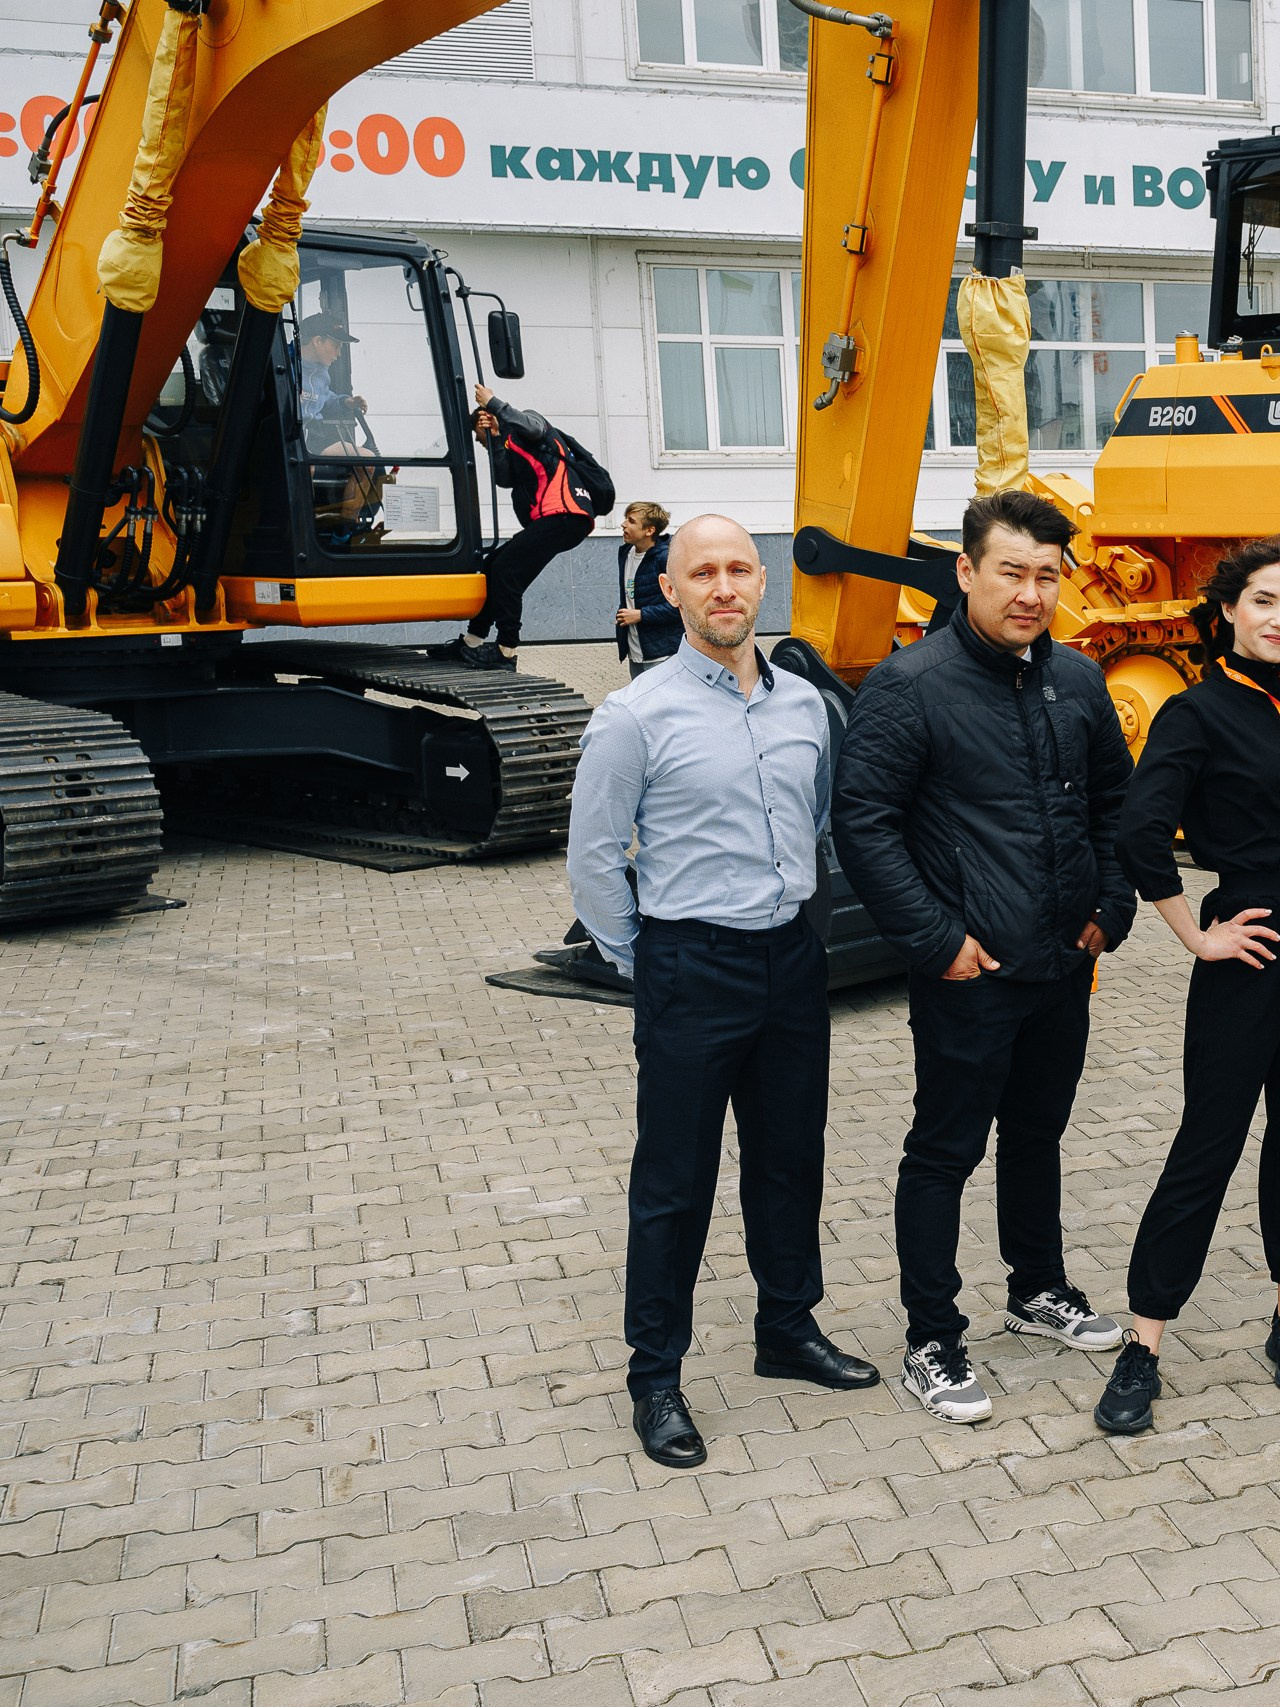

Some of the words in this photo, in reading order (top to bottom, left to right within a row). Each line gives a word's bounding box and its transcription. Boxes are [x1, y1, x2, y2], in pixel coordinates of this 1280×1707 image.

[489, 144, 771, 199] каждую
[1084, 174, 1116, 206] и
[1148, 405, 1197, 427] B260
